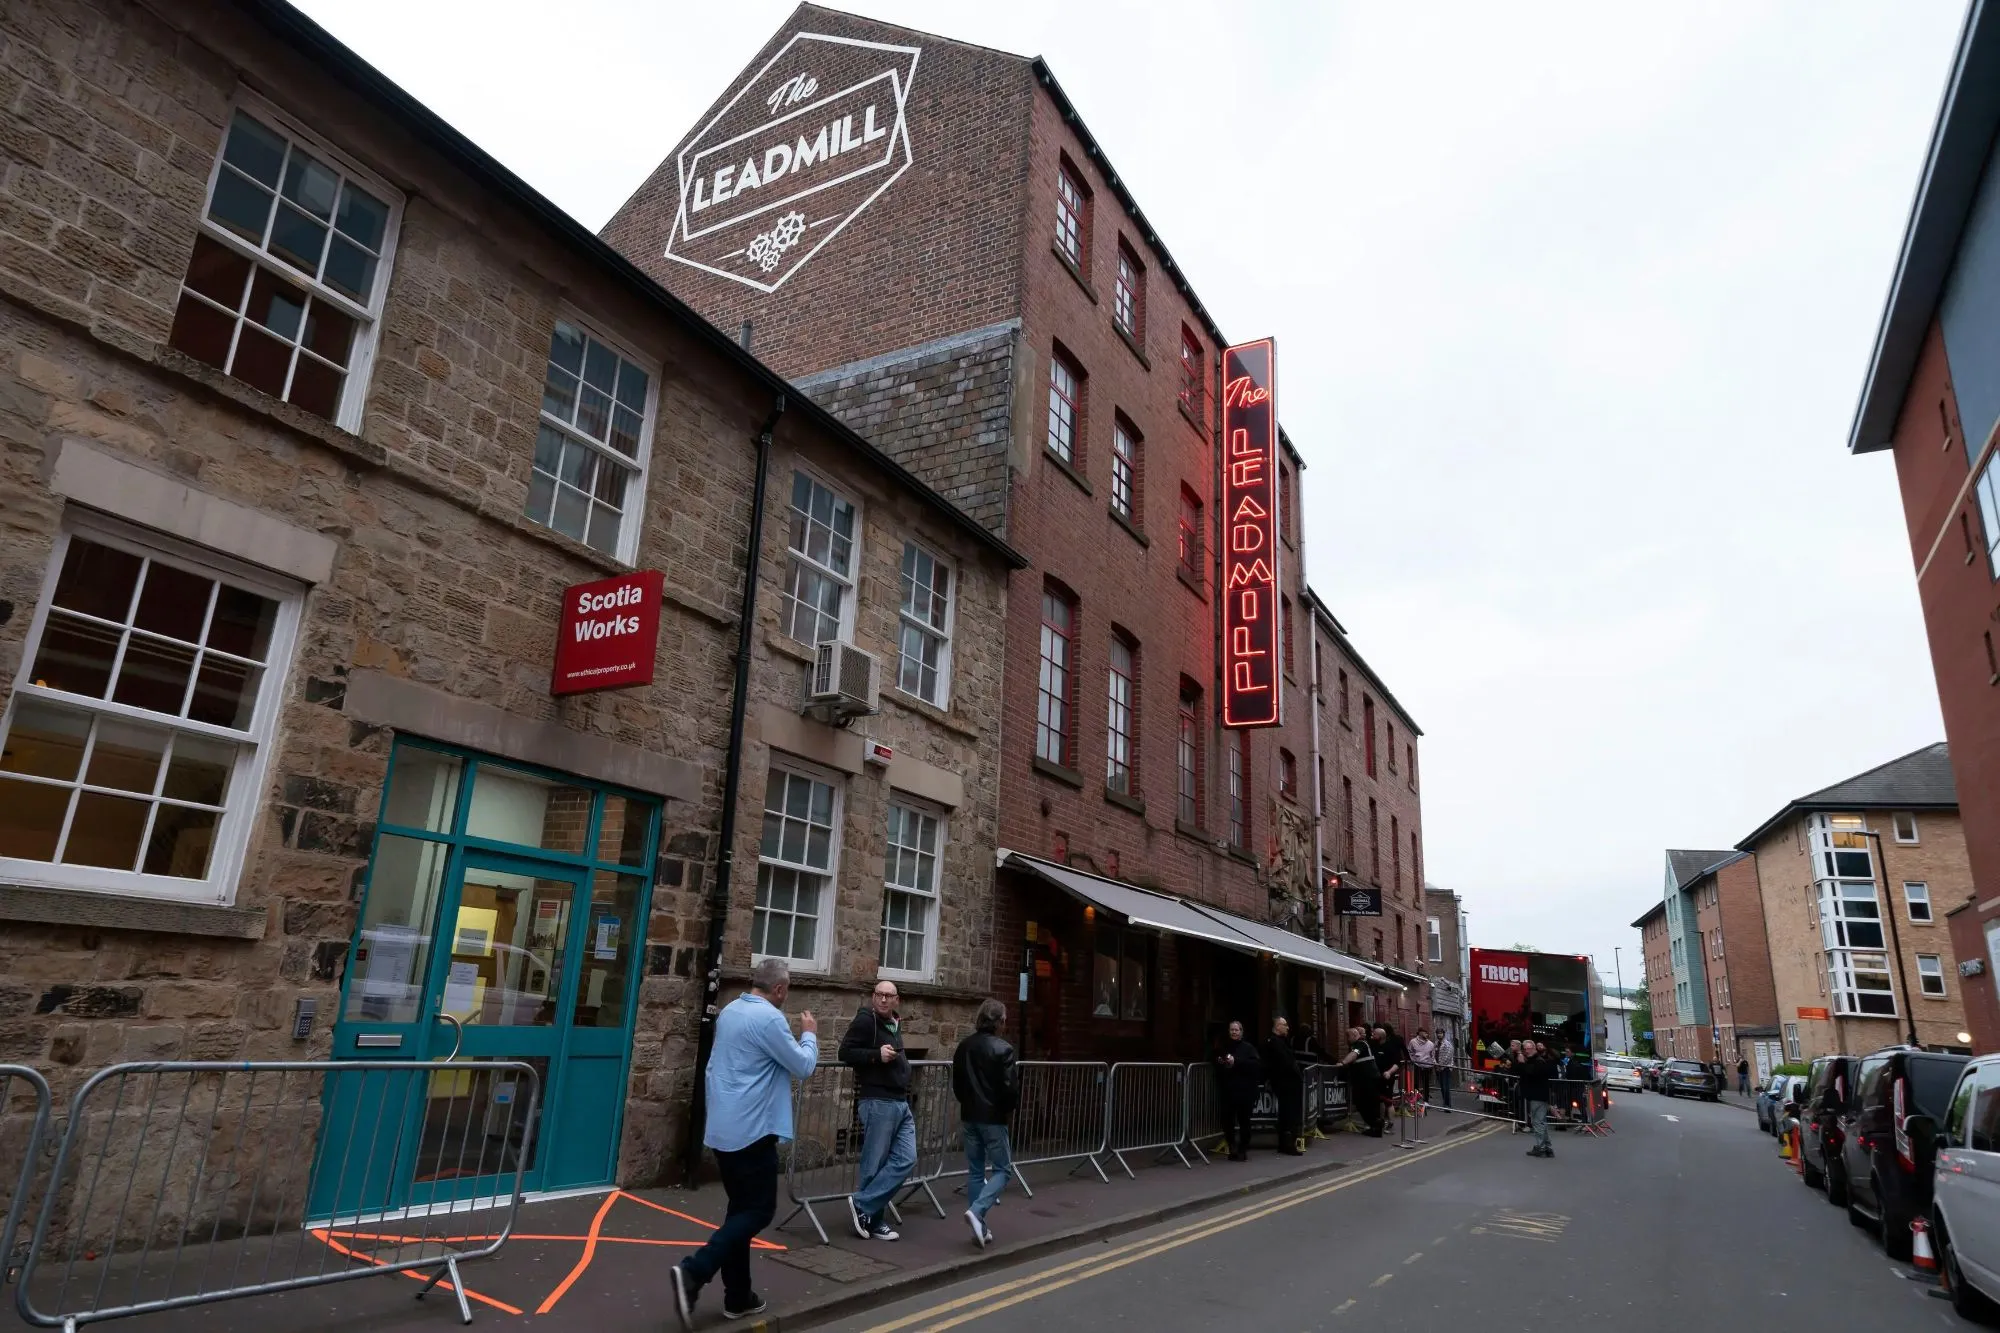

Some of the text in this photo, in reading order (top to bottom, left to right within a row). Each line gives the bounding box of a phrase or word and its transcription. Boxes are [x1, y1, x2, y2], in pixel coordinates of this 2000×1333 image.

[767, 72, 818, 115] The
[692, 104, 886, 213] LEADMILL
[1226, 376, 1269, 407] The
[1229, 427, 1272, 692] LEADMILL
[578, 585, 642, 614] Scotia
[575, 615, 640, 642] Works
